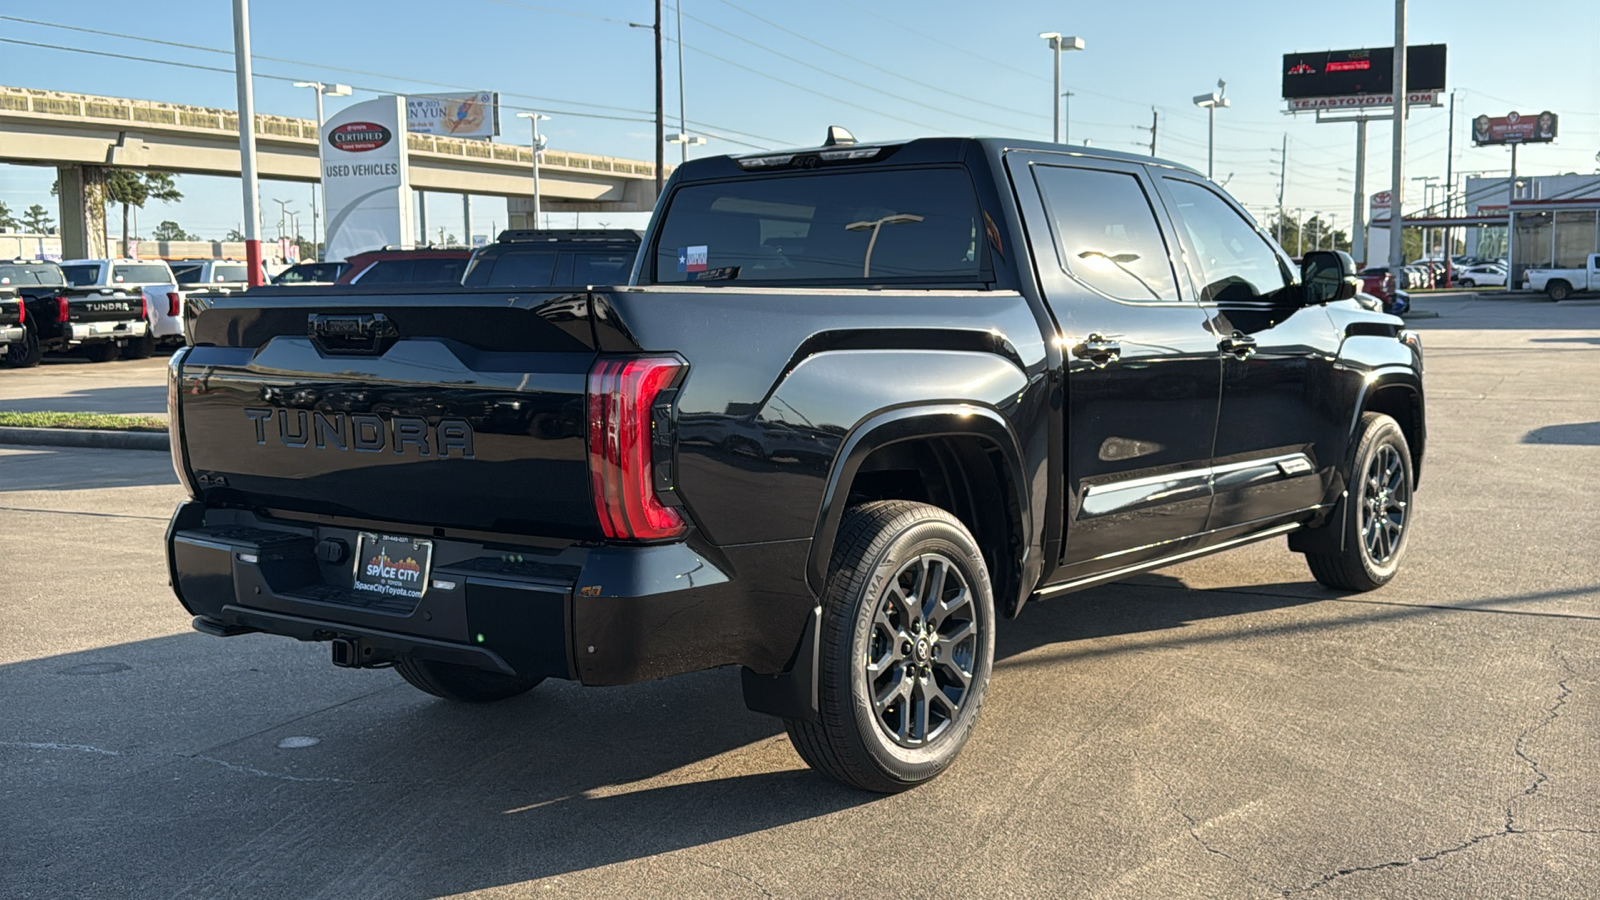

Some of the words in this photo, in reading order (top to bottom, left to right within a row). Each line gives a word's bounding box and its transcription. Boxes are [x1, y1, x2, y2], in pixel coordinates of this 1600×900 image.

[1293, 94, 1432, 107] TEJASTOYOTAOM
[421, 106, 447, 118] YUN
[335, 131, 383, 143] CERTIFIED
[326, 164, 350, 178] USED
[352, 162, 398, 177] VEHICLES
[86, 303, 129, 312] TUNDRA
[243, 407, 475, 460] TUNDRA
[366, 564, 396, 579] SPACE
[397, 568, 420, 583] CITY
[355, 580, 422, 599] SpaceCityToyota.com
[853, 573, 884, 663] YOKOHAMA
